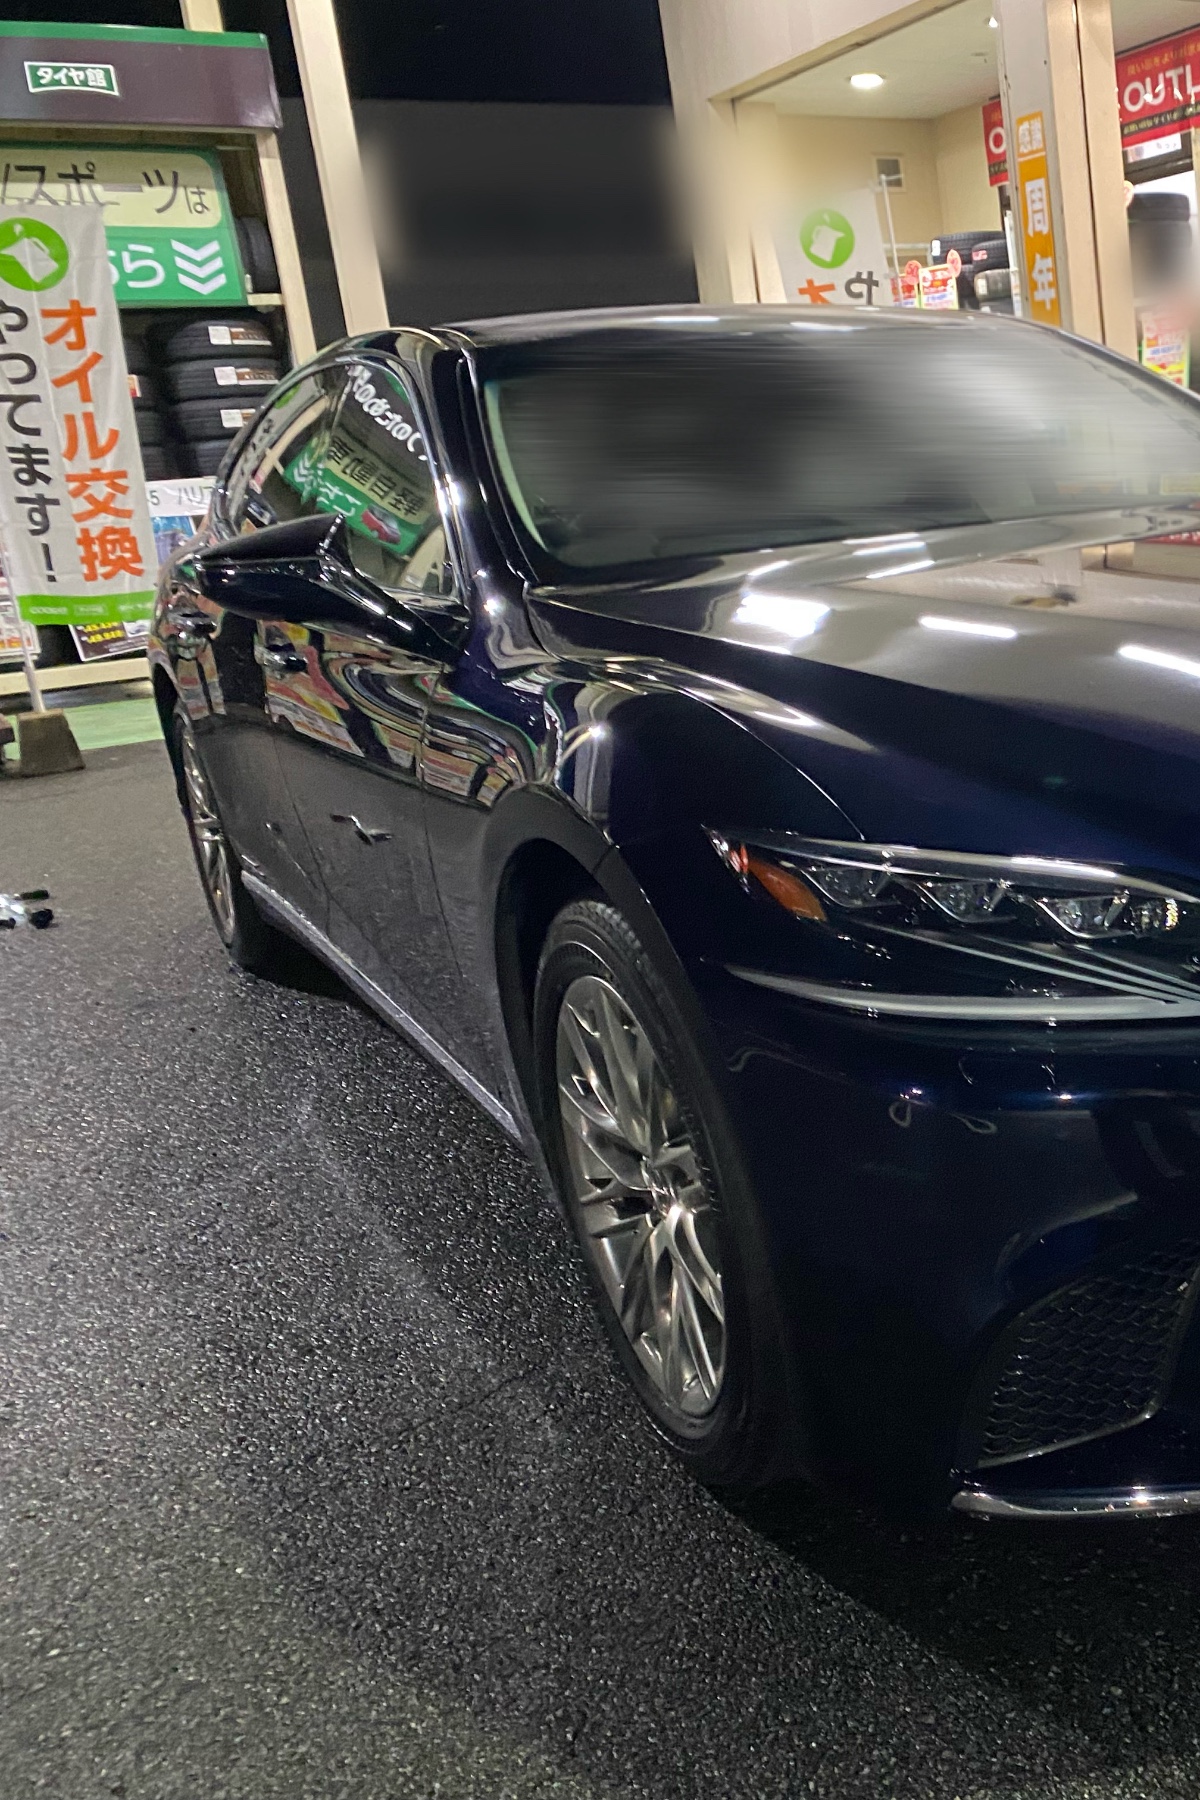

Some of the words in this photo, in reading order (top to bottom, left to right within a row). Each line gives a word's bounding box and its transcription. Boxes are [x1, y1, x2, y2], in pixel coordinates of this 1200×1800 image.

[37, 66, 108, 87] タイヤ館
[41, 299, 146, 582] オイル交換
